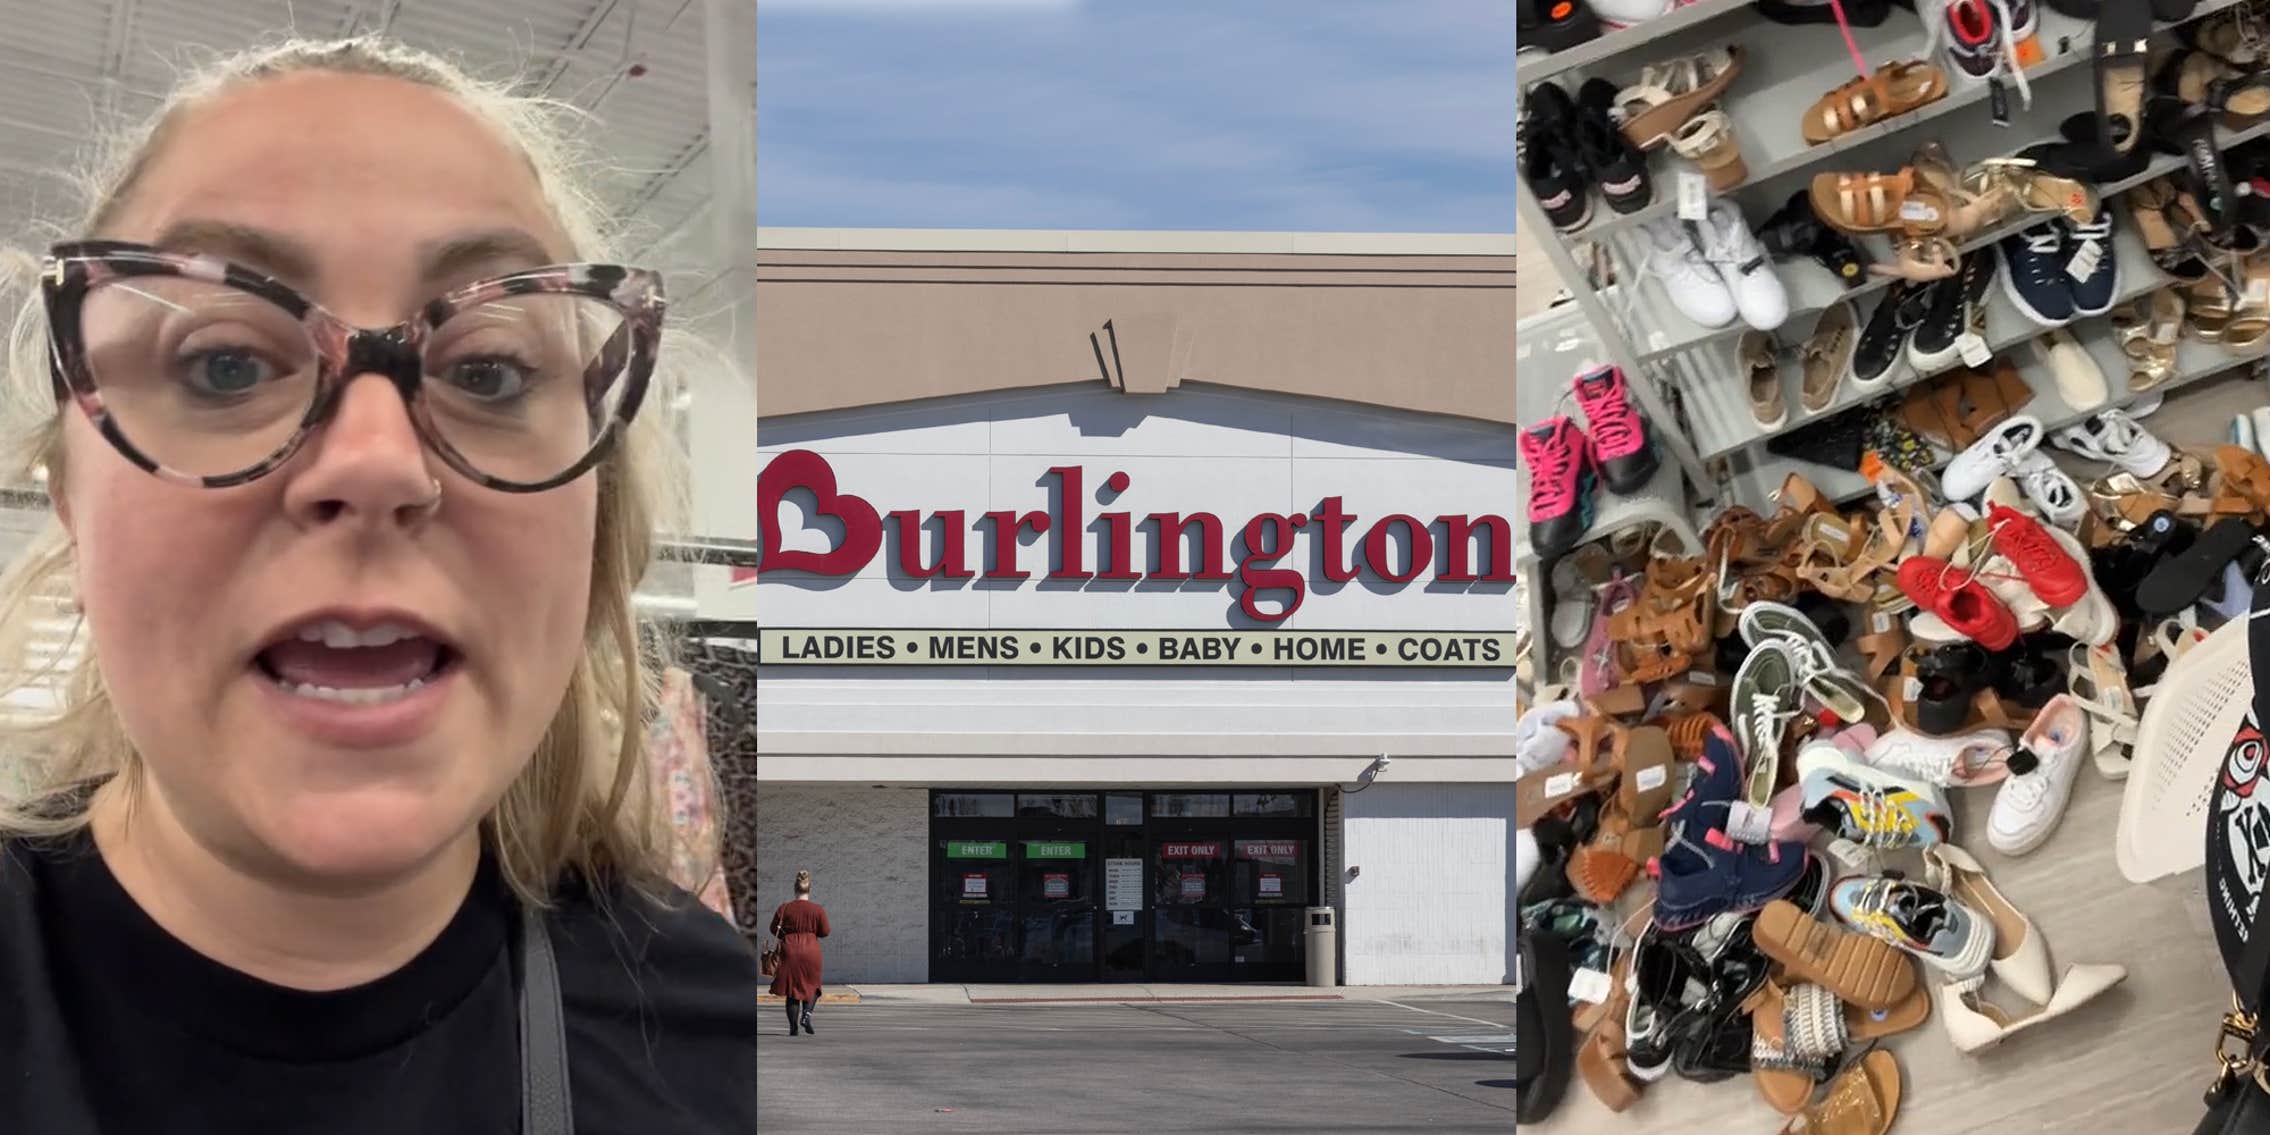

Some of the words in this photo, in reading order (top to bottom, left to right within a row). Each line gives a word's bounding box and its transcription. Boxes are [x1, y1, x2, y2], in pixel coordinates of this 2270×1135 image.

[757, 449, 1516, 621] Burlington
[782, 636, 896, 660] LADIES
[929, 636, 1019, 660] MENS
[1053, 636, 1126, 660] KIDS
[1159, 637, 1242, 661] BABY
[1274, 637, 1366, 661] HOME
[1398, 637, 1501, 661] COATS
[961, 845, 993, 856] ENTER
[1040, 846, 1072, 856] ENTER
[1167, 845, 1189, 856] EXIT
[1191, 845, 1215, 856] ONLY
[1247, 845, 1267, 856] EXIT
[1270, 845, 1294, 856] ONLY
